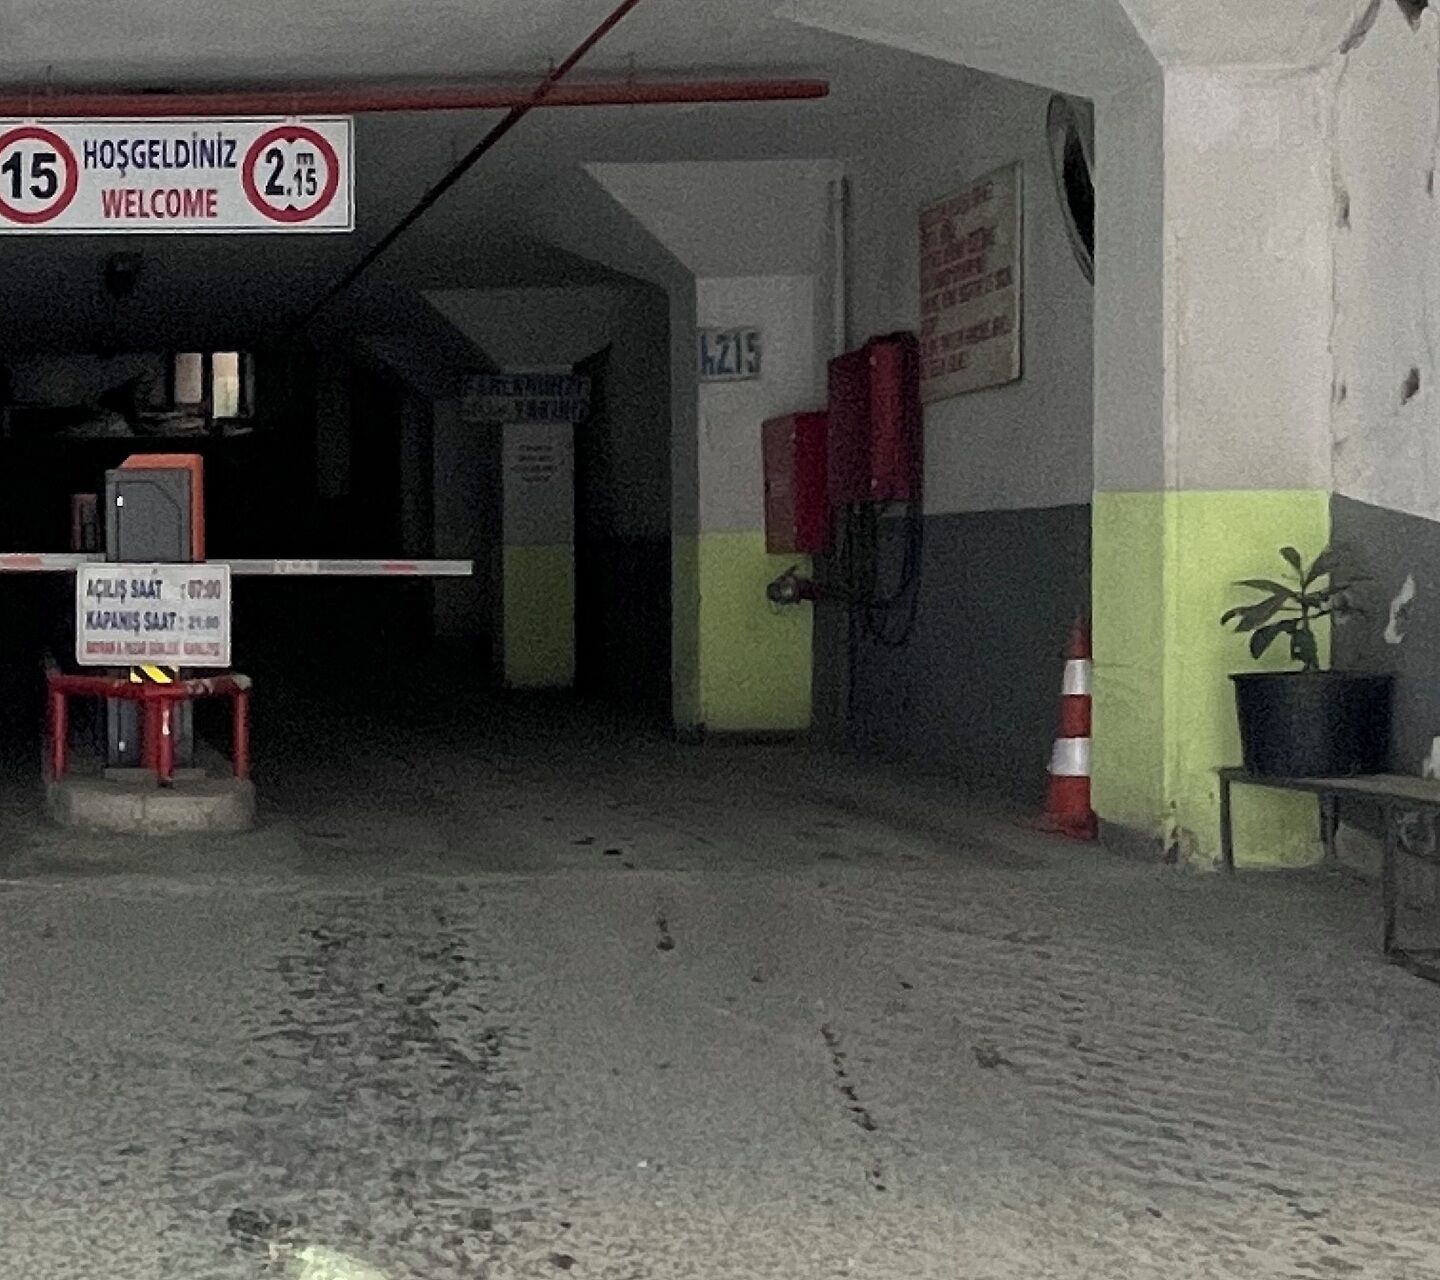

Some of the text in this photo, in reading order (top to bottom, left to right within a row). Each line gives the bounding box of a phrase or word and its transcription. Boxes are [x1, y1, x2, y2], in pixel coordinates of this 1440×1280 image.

[83, 132, 237, 178] HOŞGELDİNİZ
[1, 151, 58, 200] 15
[101, 189, 218, 219] WELCOME
[87, 579, 127, 604] AÇILIŞ
[86, 610, 140, 636] KAPANIŞ
